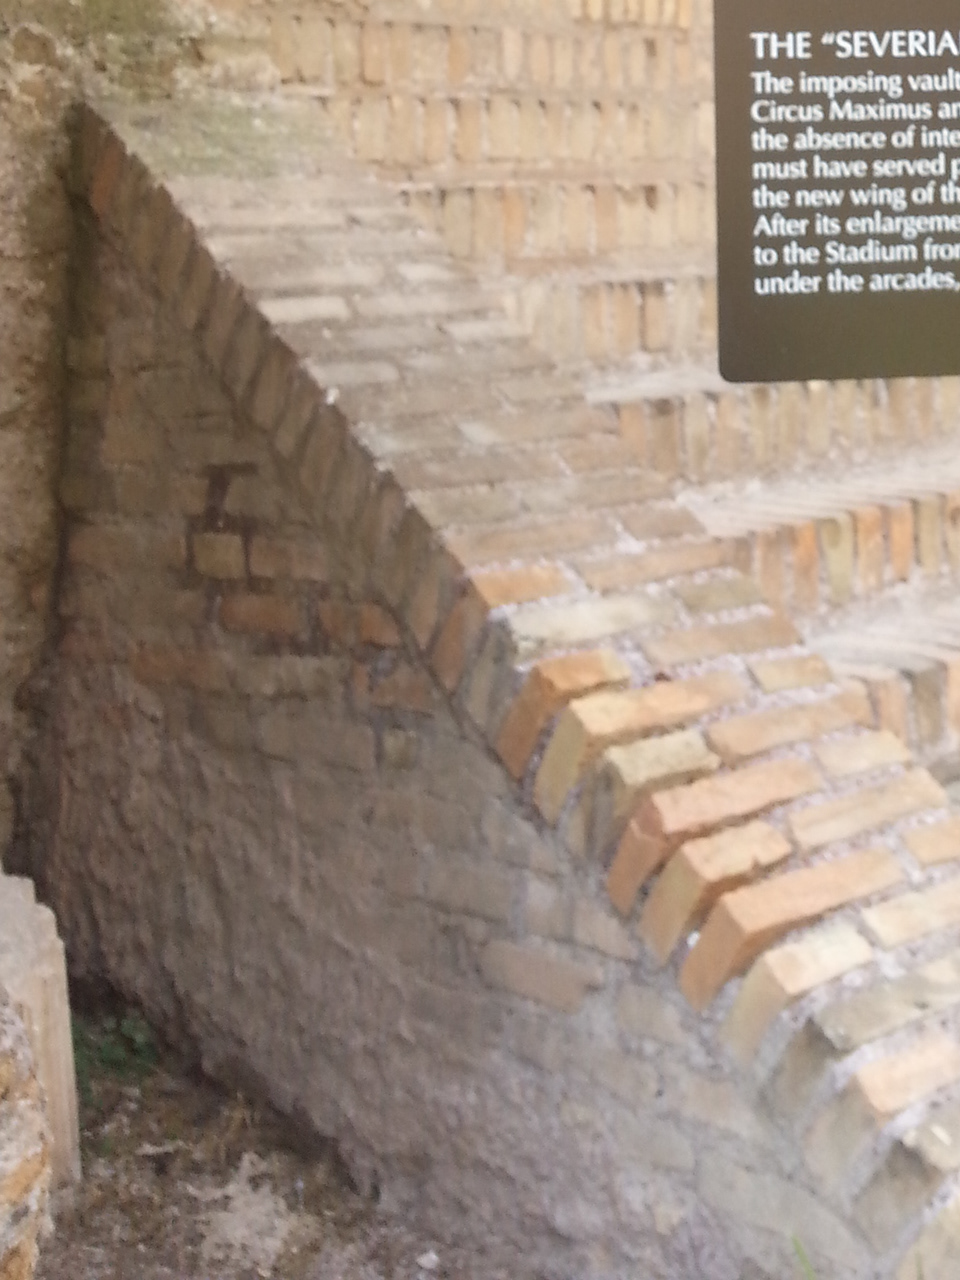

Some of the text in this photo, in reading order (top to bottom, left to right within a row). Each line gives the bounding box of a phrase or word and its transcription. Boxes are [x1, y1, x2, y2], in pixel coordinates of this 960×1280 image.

[749, 32, 811, 60] THE
[751, 71, 793, 94] The
[799, 69, 903, 98] imposing
[750, 99, 823, 122] Circus
[828, 97, 932, 121] Maximus
[751, 128, 788, 151] the
[793, 127, 886, 150] absence
[890, 126, 914, 148] of
[752, 159, 807, 179] must
[813, 155, 867, 178] have
[872, 153, 945, 177] served
[752, 186, 790, 209] the
[794, 190, 844, 208] new
[849, 183, 907, 211] wing
[910, 182, 934, 205] of
[753, 214, 809, 237] After
[815, 213, 841, 236] its
[753, 246, 777, 266] to
[782, 242, 820, 265] the
[824, 240, 917, 264] Stadium
[754, 271, 822, 294] under
[826, 270, 864, 293] the
[868, 267, 960, 294] arcades,
